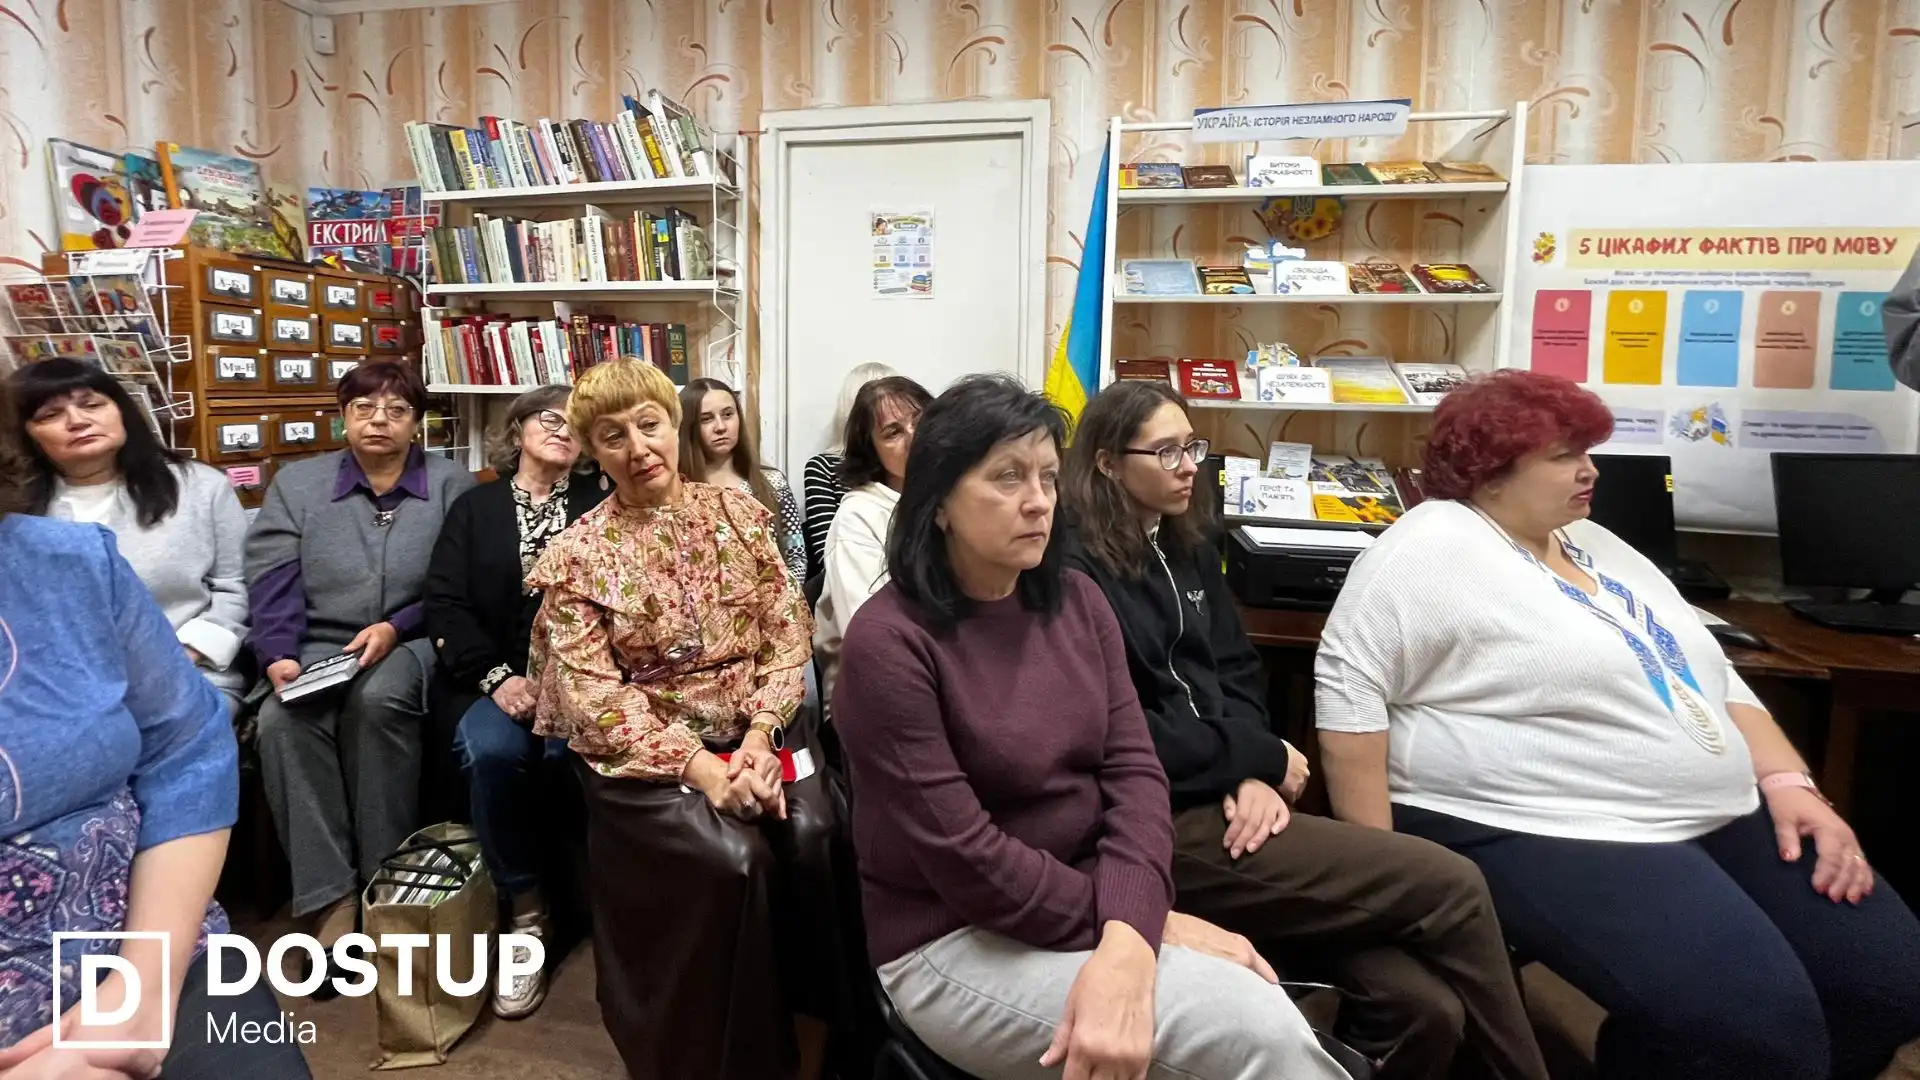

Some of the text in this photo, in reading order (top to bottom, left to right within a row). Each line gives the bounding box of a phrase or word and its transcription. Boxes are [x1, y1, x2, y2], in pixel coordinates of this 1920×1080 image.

[1253, 116, 1290, 127] ІСТОРІЯ
[1292, 113, 1356, 126] НЕЗЛАМНОГО
[1357, 111, 1398, 123] НАРОДУ
[1578, 237, 1592, 255] 5
[1699, 236, 1780, 255] ФАКТІВ
[1787, 236, 1827, 255] ПРО
[1833, 236, 1898, 255] МОВУ
